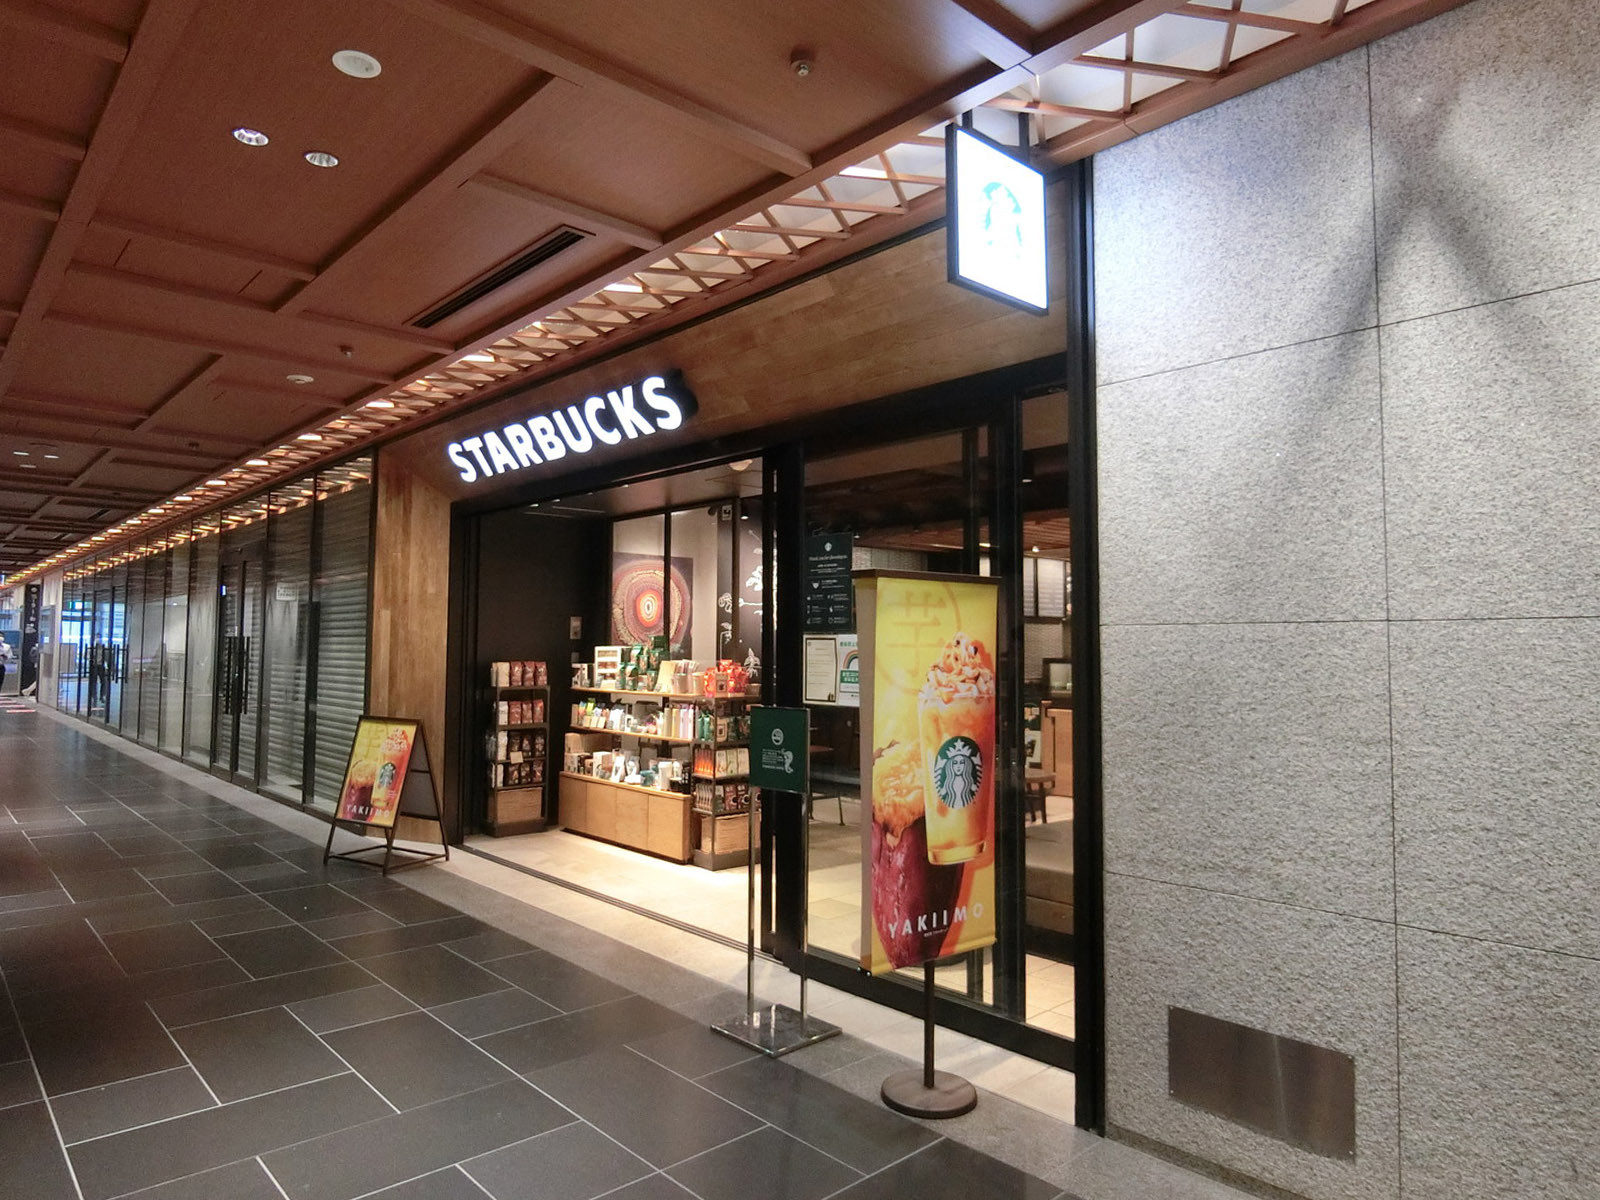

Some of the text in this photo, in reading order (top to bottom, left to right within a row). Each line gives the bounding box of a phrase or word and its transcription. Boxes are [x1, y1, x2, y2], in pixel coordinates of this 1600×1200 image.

[448, 376, 682, 483] STARBUCKS
[346, 804, 390, 818] YAKIIMO
[888, 902, 984, 939] YAKIIMO
